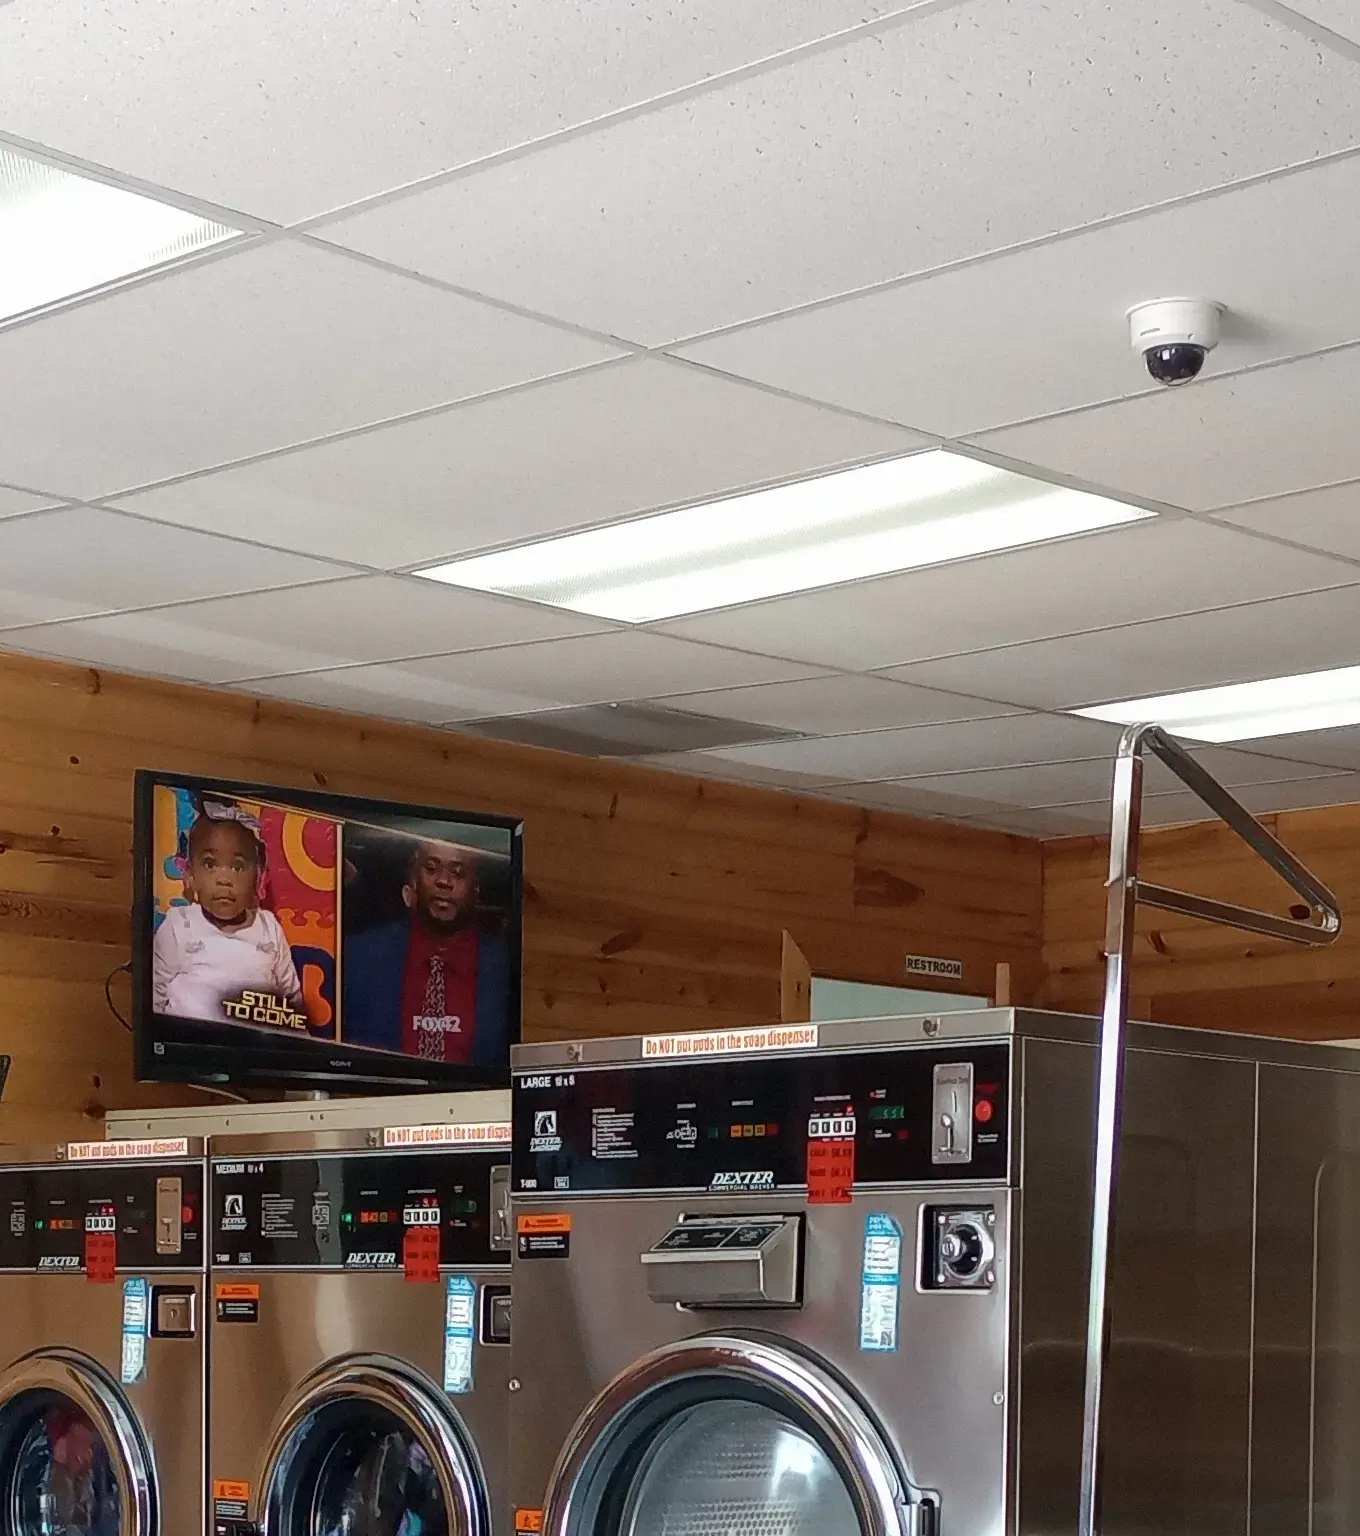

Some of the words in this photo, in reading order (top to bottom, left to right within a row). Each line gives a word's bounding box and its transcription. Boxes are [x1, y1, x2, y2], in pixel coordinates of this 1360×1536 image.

[907, 958, 961, 975] RESTROOM
[240, 990, 295, 1013] STILL
[223, 1001, 250, 1019] TO
[253, 1006, 307, 1030] COME
[412, 1015, 462, 1033] FOX42
[646, 1039, 657, 1055] Do
[659, 1038, 674, 1054] NOT
[677, 1039, 691, 1055] put
[693, 1036, 714, 1054] pods
[717, 1035, 725, 1050] in
[727, 1033, 741, 1049] the
[743, 1032, 765, 1049] soap
[767, 1029, 816, 1048] dispenser.
[521, 1076, 551, 1089] LARGE
[397, 1128, 411, 1142] NOT
[445, 1126, 452, 1140] in
[453, 1126, 466, 1140] the
[712, 1171, 774, 1185] DEXTER
[39, 1256, 80, 1268] DEXTER
[346, 1252, 397, 1265] DEXTER
